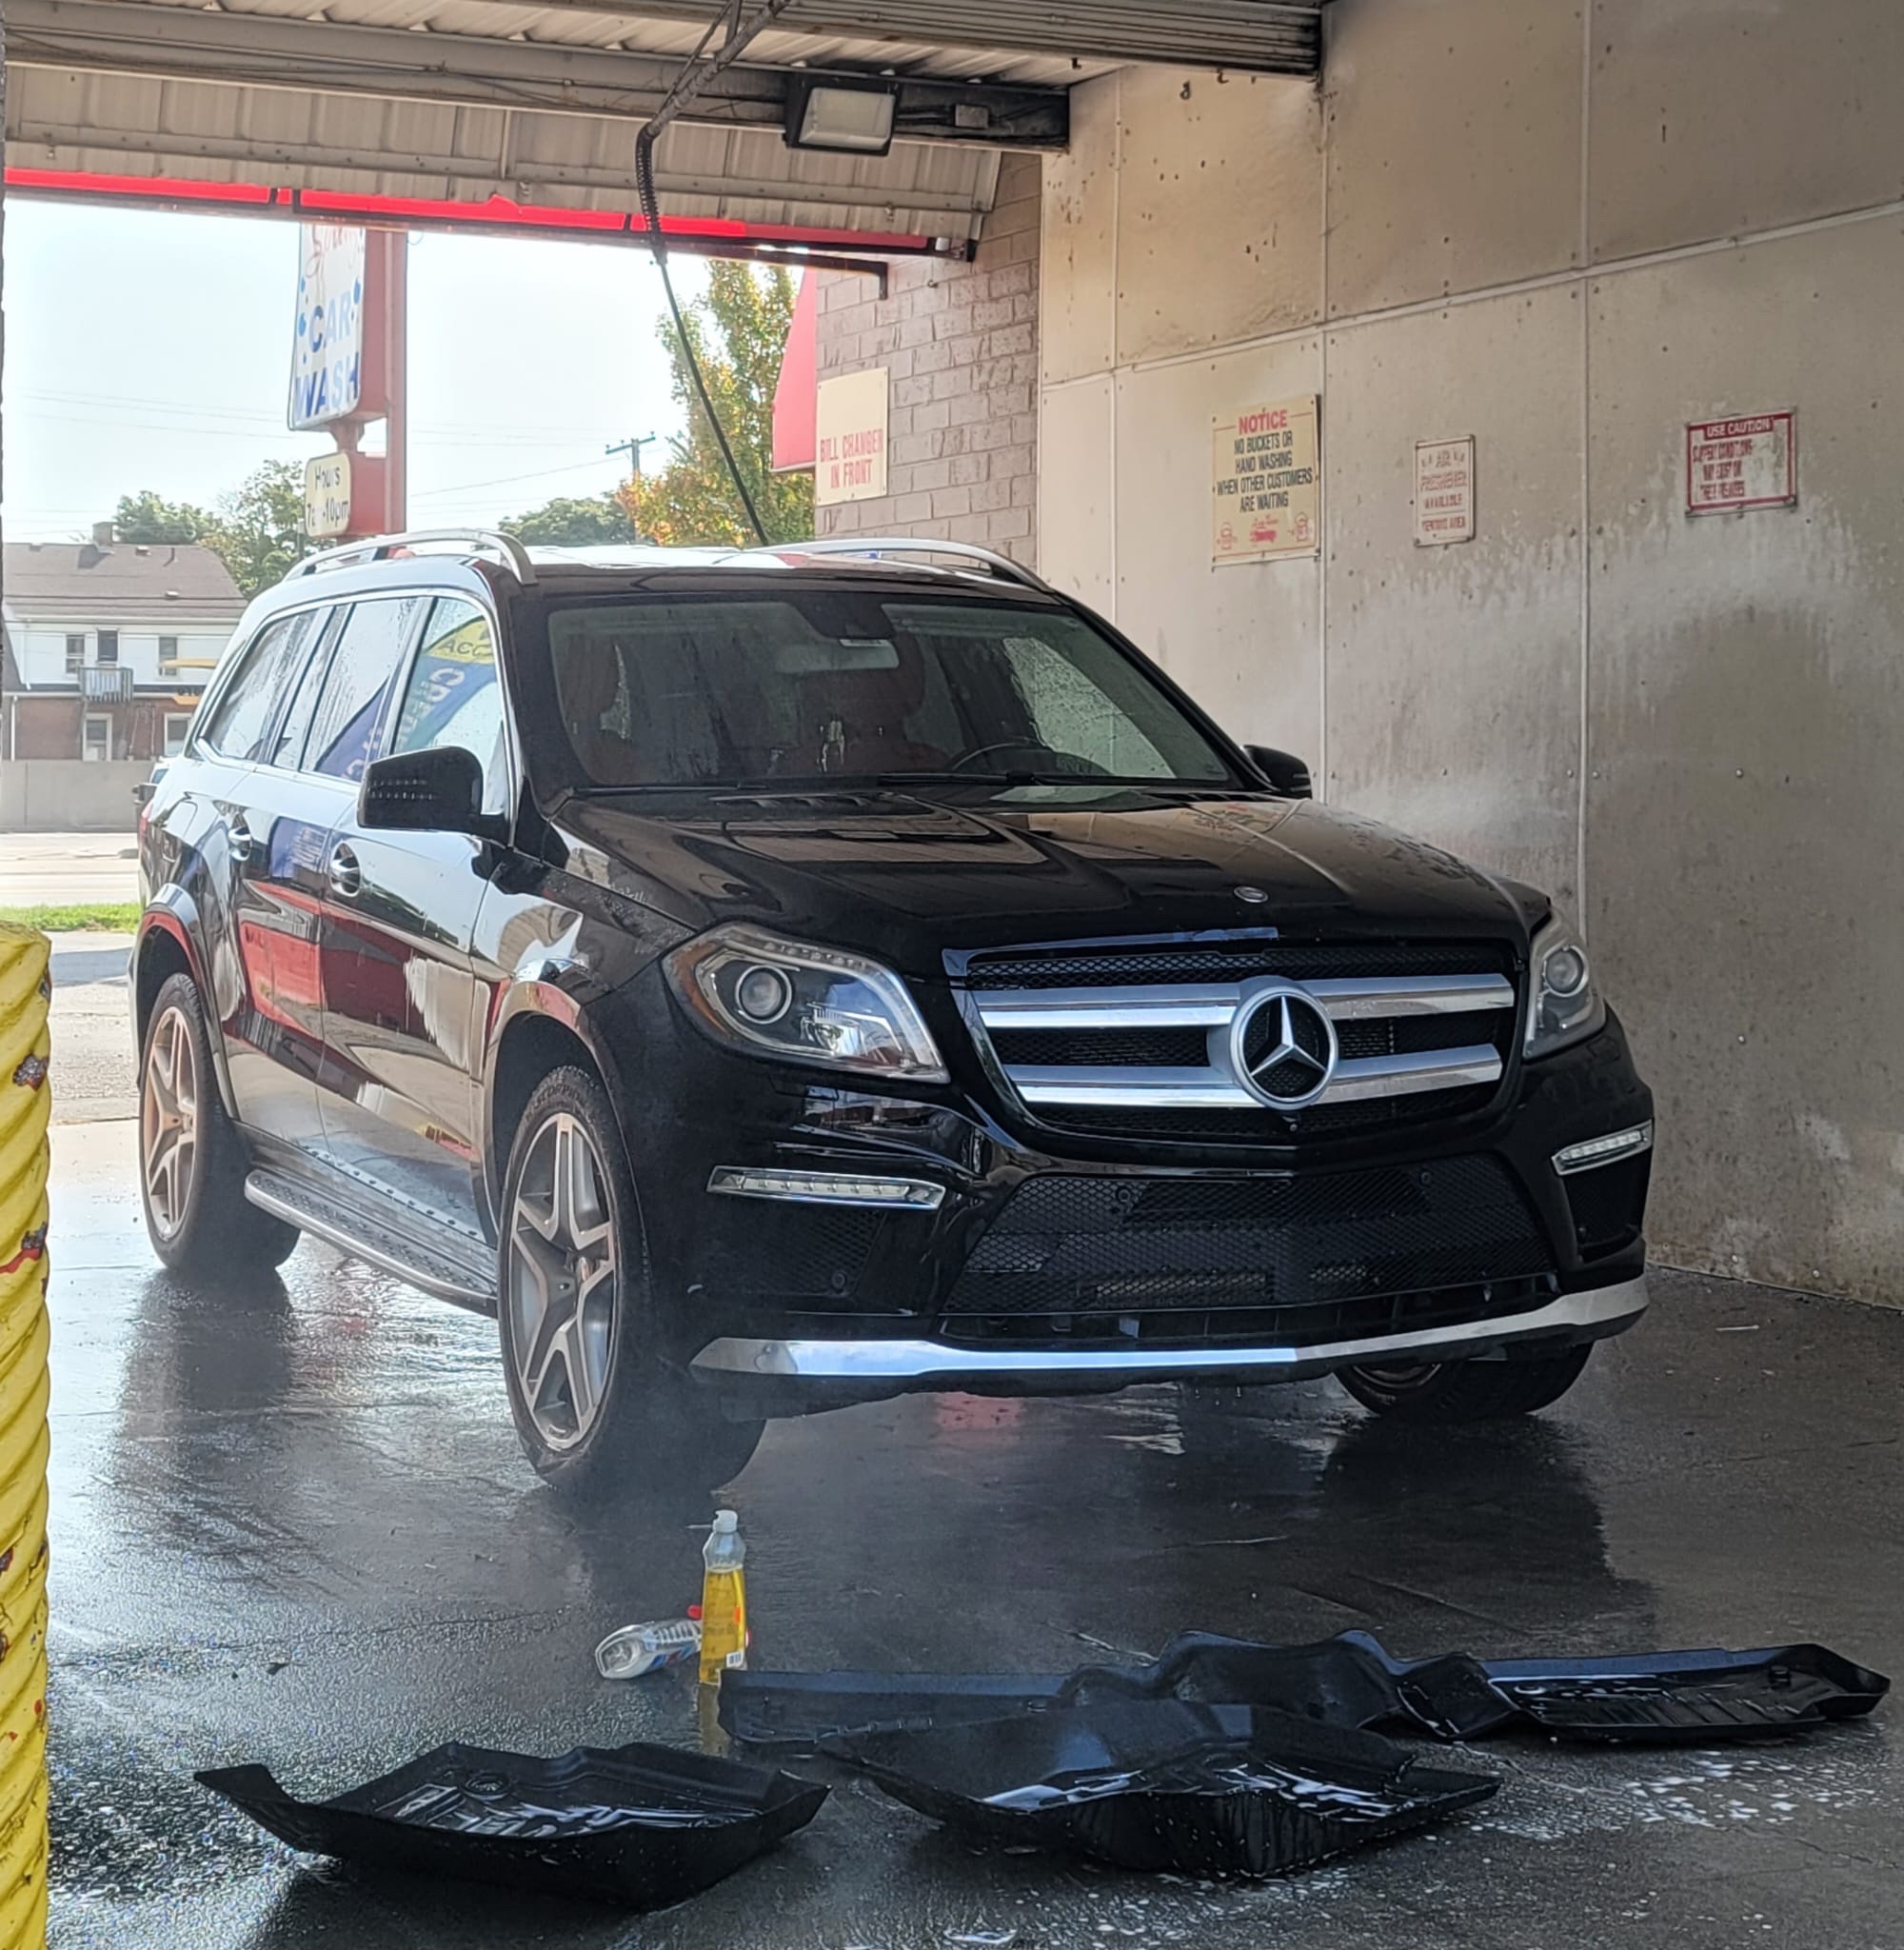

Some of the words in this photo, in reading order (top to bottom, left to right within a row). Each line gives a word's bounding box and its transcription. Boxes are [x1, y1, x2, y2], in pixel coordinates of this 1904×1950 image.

[308, 291, 351, 353] CAR
[295, 351, 360, 420] WASH
[1239, 409, 1288, 435] NOTICE
[1706, 424, 1726, 438] USE
[1727, 418, 1771, 435] CAUTION
[820, 437, 839, 463] BILL
[843, 428, 883, 459] CHANGER
[1234, 438, 1245, 455] NO
[1246, 432, 1280, 453] BUCKETS
[1281, 430, 1294, 448] OR
[831, 465, 840, 488] IN
[843, 458, 873, 488] FRONT
[1235, 457, 1256, 474] HAND
[1259, 450, 1293, 470] WASHING
[1217, 478, 1239, 496] WHEN
[1240, 474, 1265, 493] OTHER
[1267, 467, 1313, 489] CUSTOMERS
[1240, 495, 1256, 513] ARE
[1257, 490, 1289, 510] WAITING
[533, 1083, 585, 1109] SCORPIO
